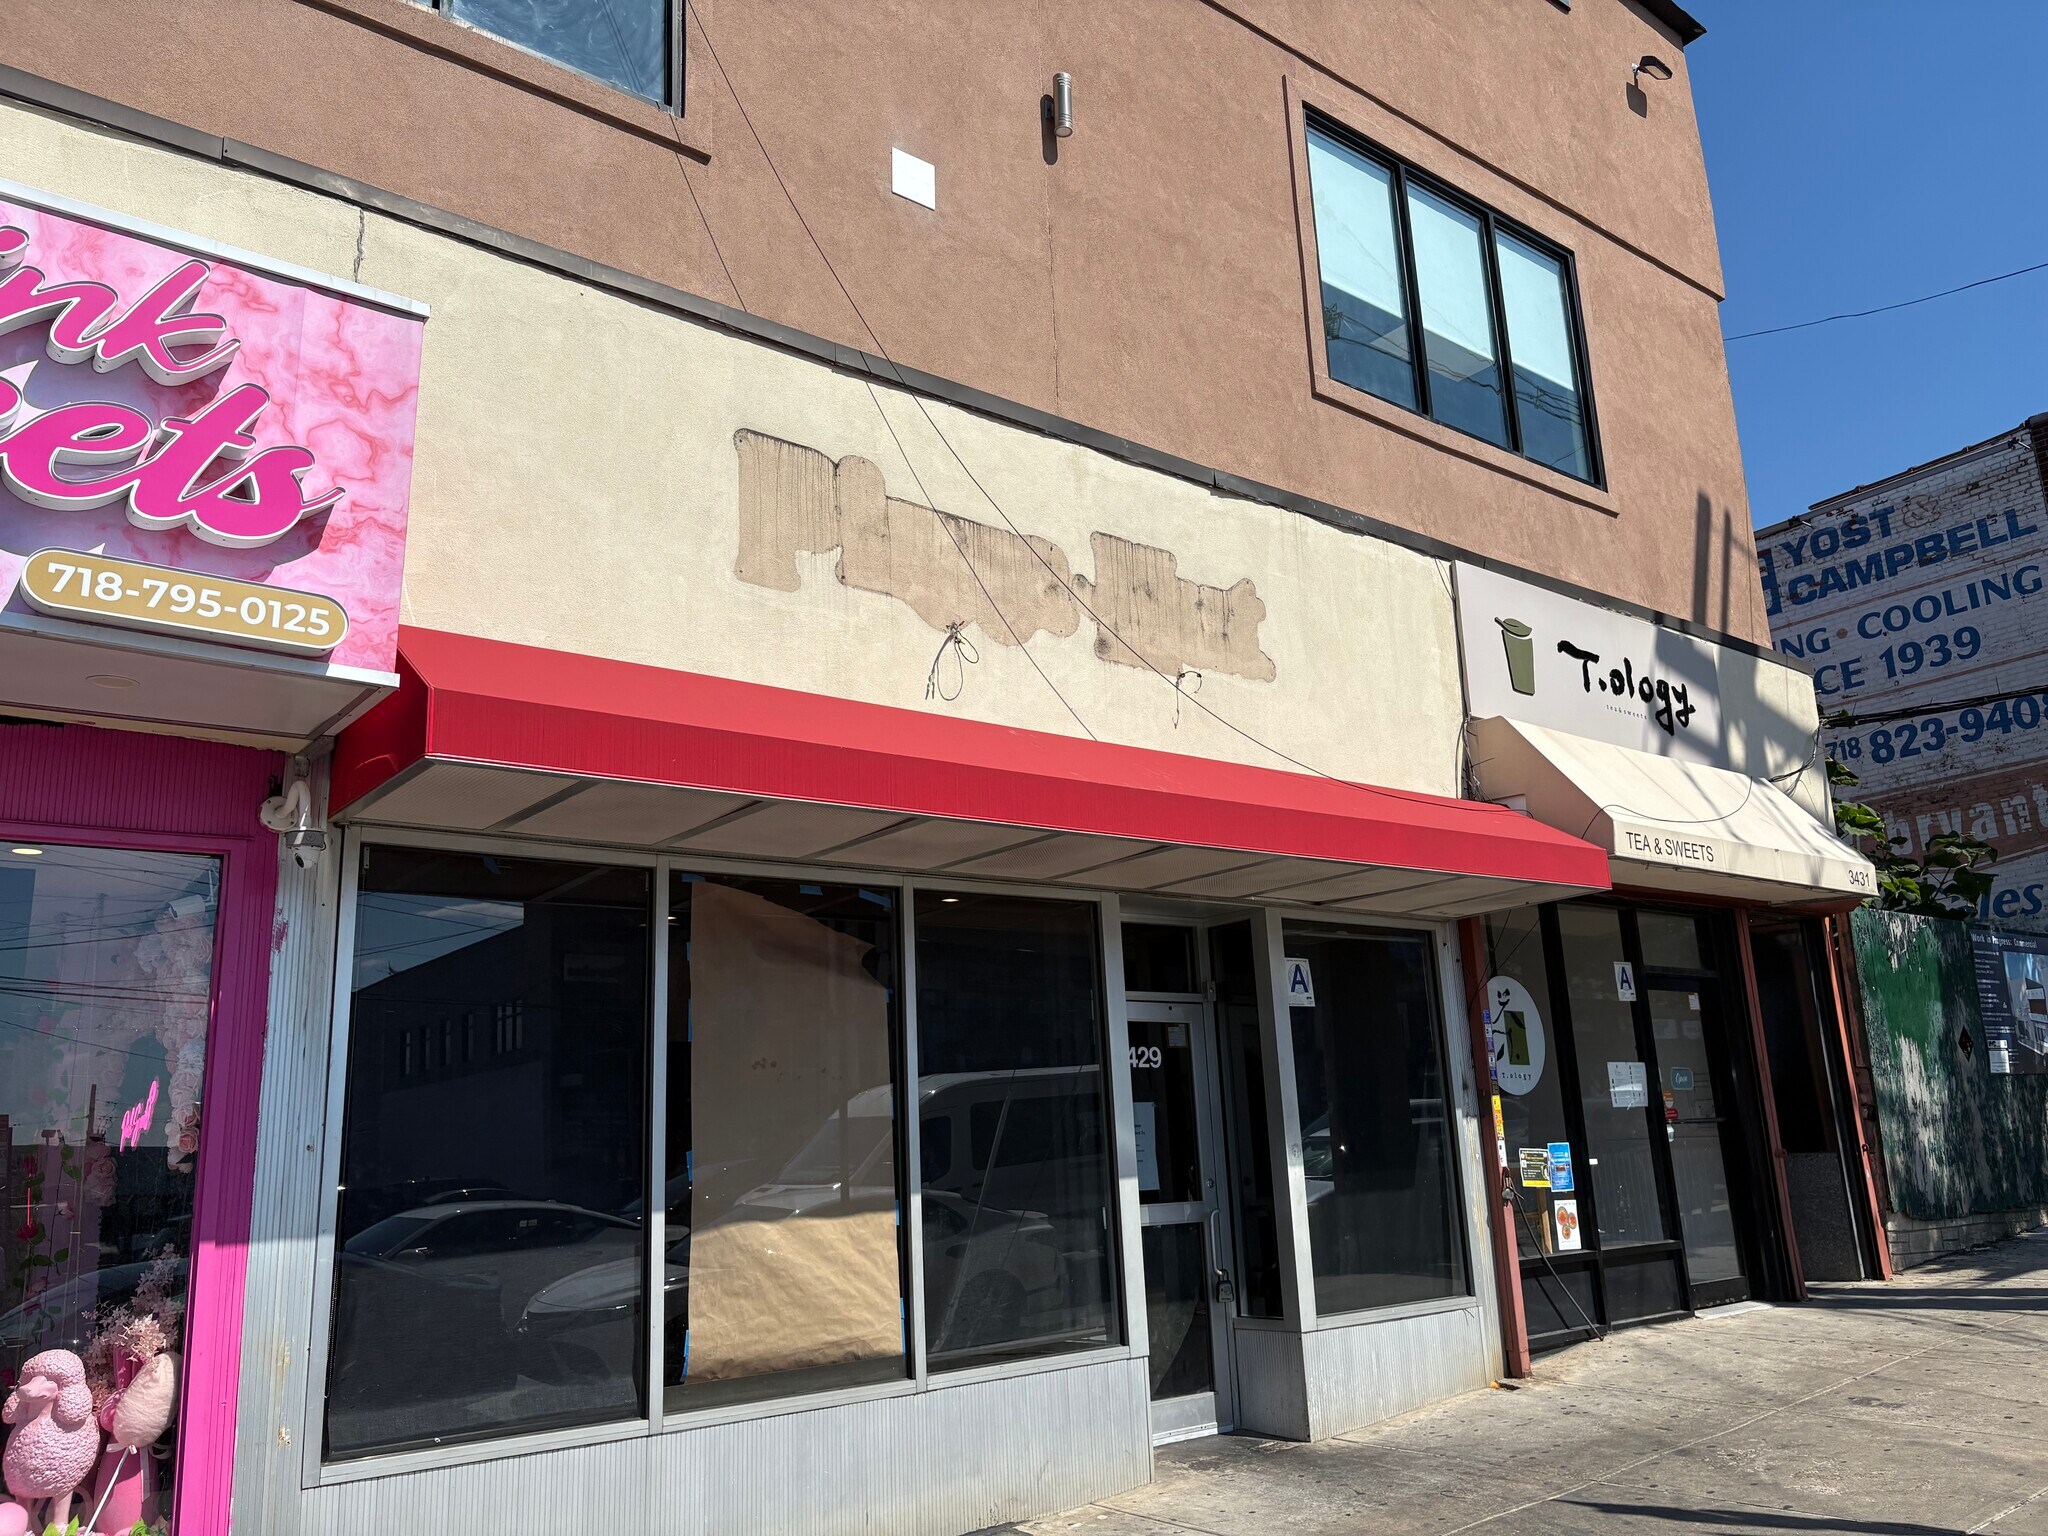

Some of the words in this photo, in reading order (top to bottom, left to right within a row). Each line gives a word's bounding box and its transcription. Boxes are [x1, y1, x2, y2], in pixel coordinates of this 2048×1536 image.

[0, 226, 241, 386] nk
[1779, 505, 1895, 567] YOST
[1788, 508, 2038, 606] CAMPBELL
[47, 562, 330, 636] 718-795-0125
[1773, 627, 1830, 659] NG
[1857, 565, 2043, 640] COOLING
[1879, 626, 1981, 680] 1939
[1557, 640, 1695, 736] T.ology
[1825, 736, 1862, 761] 718
[1625, 831, 1652, 853] TEA
[1654, 838, 1663, 855] &
[1665, 840, 1715, 863] SWEETS
[1848, 869, 1871, 888] 3431
[1971, 933, 1985, 943] Work
[1291, 964, 1309, 993] A
[1620, 966, 1632, 990] A
